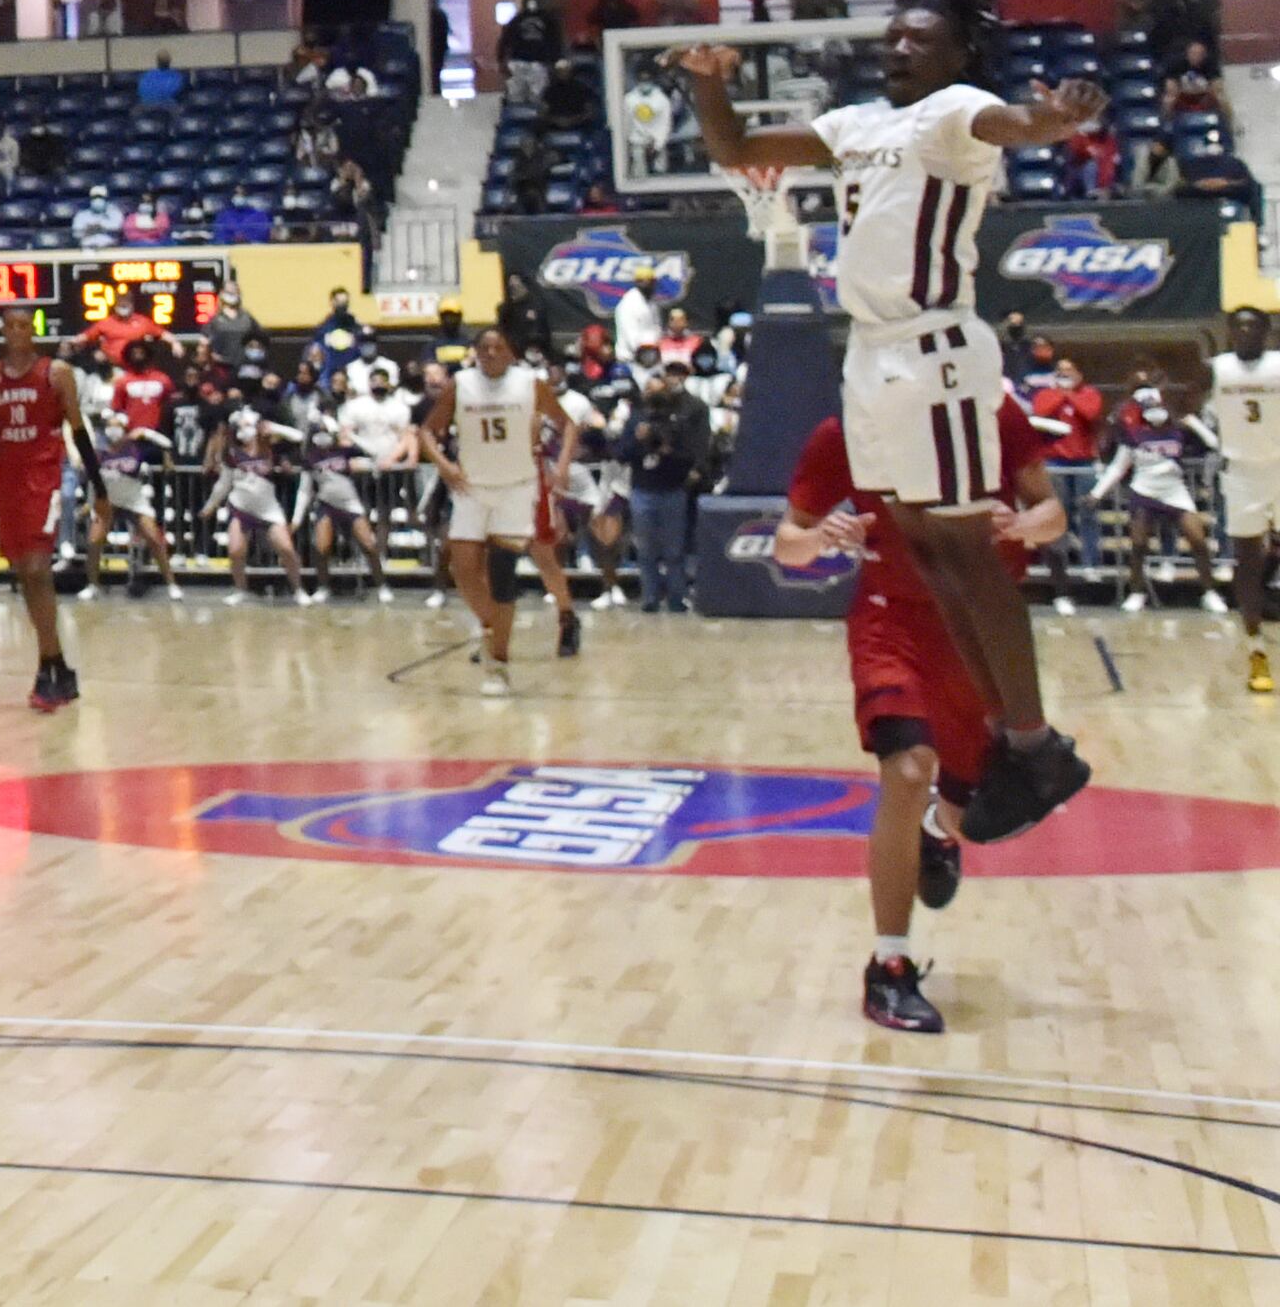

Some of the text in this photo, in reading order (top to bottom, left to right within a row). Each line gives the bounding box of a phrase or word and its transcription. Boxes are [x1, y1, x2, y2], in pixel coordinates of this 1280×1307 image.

[543, 255, 683, 285] GHSA
[1007, 244, 1163, 276] GHSA
[152, 293, 175, 325] 2
[941, 361, 958, 390] C
[1244, 399, 1262, 423] 3
[480, 417, 508, 443] 15
[437, 765, 708, 866] GHSA
